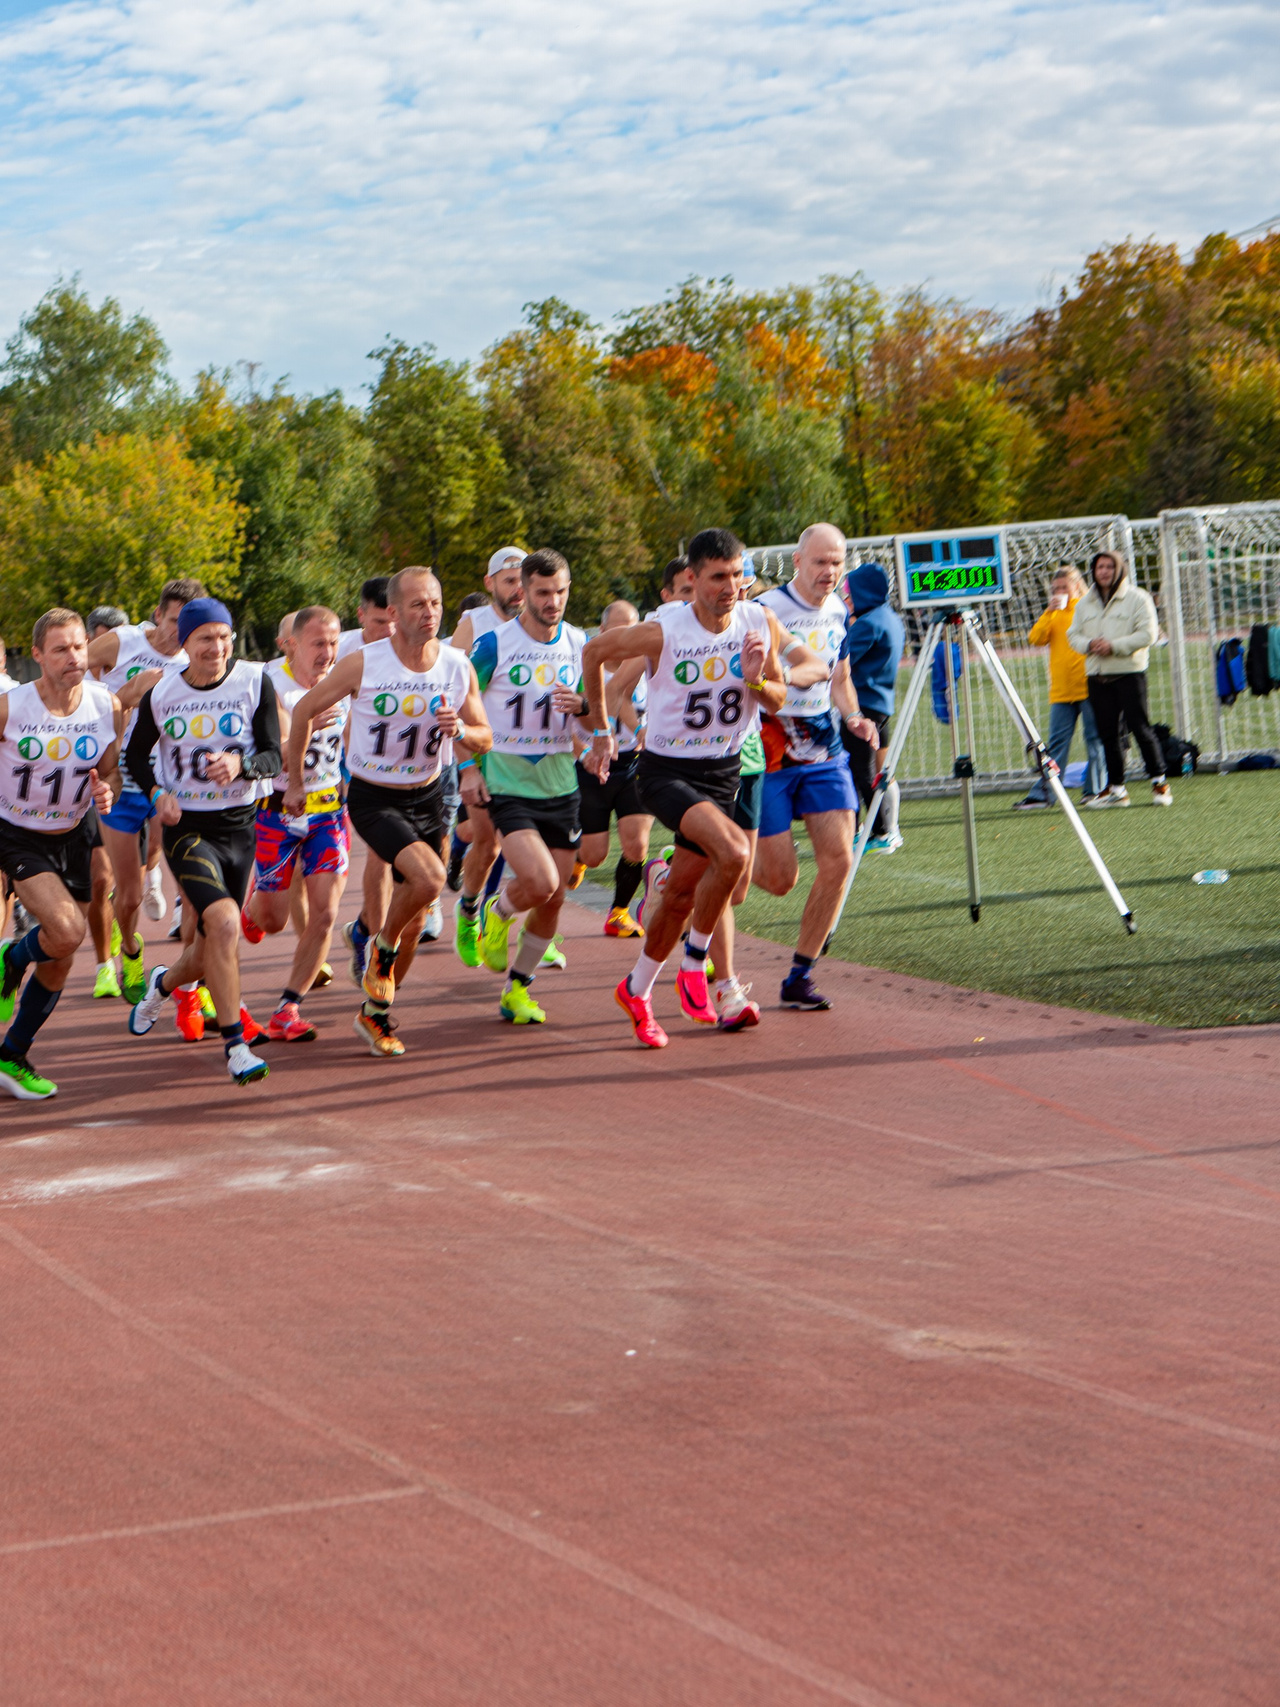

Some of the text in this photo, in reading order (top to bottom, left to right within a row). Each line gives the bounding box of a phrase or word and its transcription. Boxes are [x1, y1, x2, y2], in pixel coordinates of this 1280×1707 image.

[18, 722, 99, 735] VMARAFONE
[682, 686, 745, 732] 58
[367, 720, 445, 761] 118
[10, 763, 93, 807] 117
